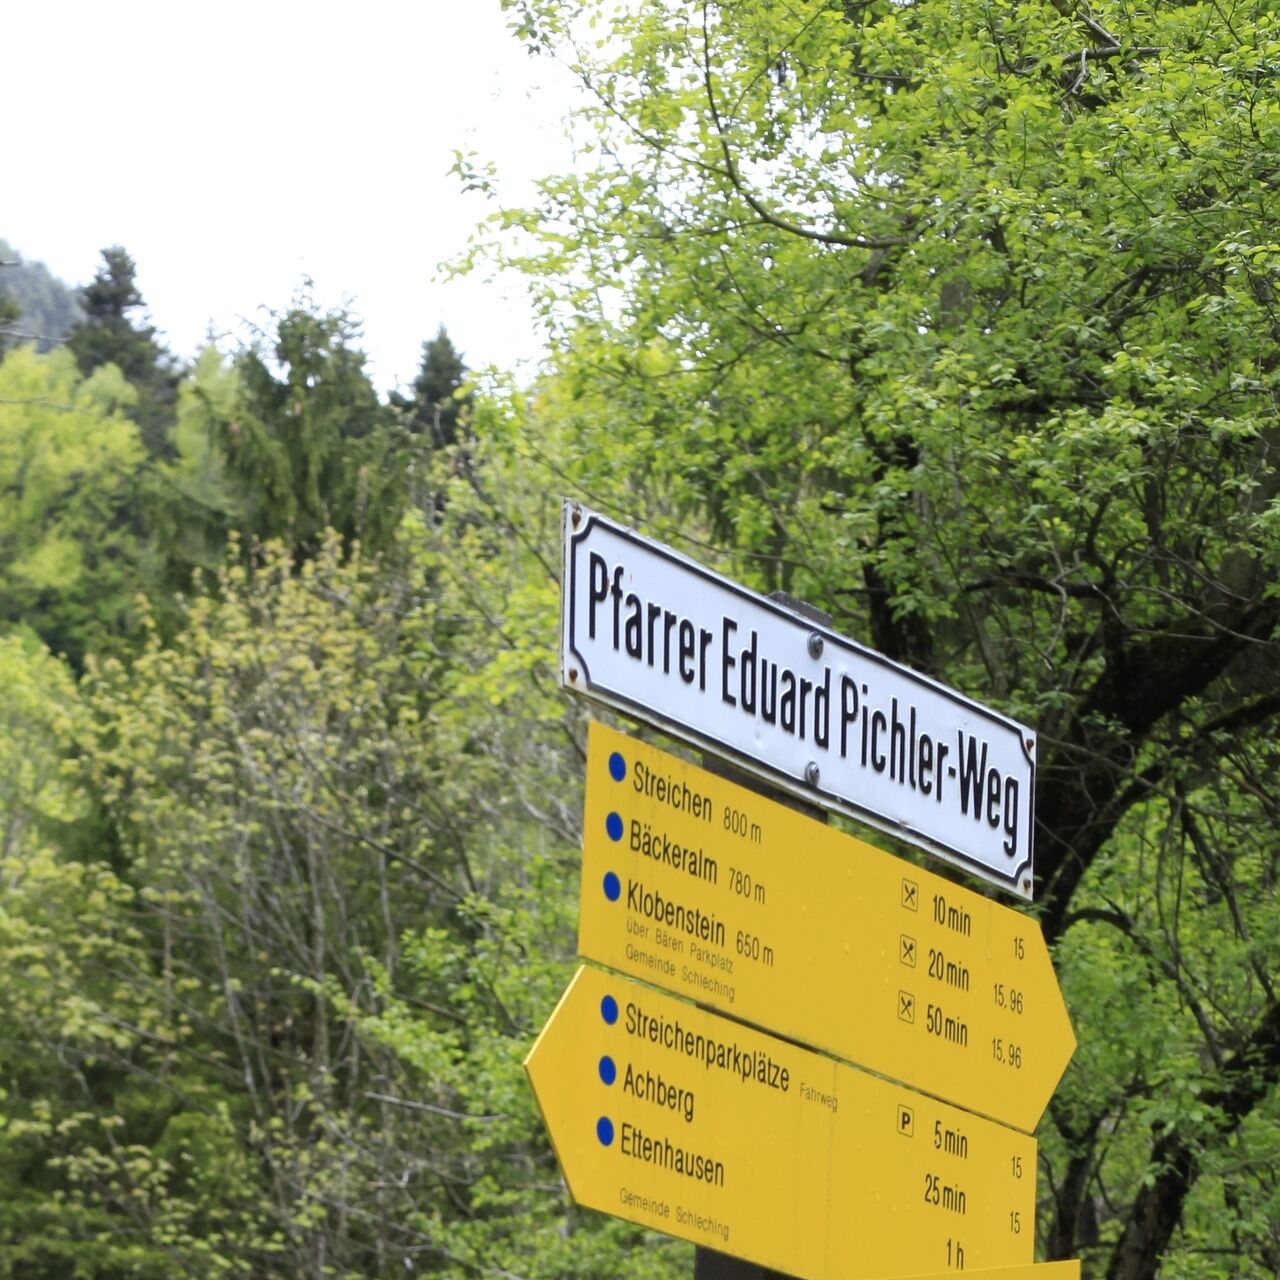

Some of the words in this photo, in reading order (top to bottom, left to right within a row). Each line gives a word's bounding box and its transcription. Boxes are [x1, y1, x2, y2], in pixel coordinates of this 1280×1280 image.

[588, 550, 713, 691] Pfarrer
[722, 616, 831, 750] Eduard
[840, 674, 1019, 857] Pichler-Weg
[633, 760, 712, 823] Streichen
[724, 806, 747, 837] 800
[751, 823, 761, 844] m
[630, 819, 717, 884] Bäckeralm
[729, 867, 751, 898] 780
[755, 884, 765, 904] m
[627, 879, 725, 947] Klobenstein
[736, 930, 760, 961] 650
[762, 946, 773, 967] m
[933, 894, 945, 925] 10
[948, 906, 971, 937] min
[627, 916, 649, 939] über
[655, 928, 684, 953] Bären
[690, 942, 734, 974] Parkplatz
[928, 948, 944, 981] 20
[946, 961, 970, 992] min
[1014, 937, 1025, 960] 15
[626, 943, 676, 976] Gemeinde
[682, 966, 735, 1003] Schleching
[926, 1003, 942, 1036] 50
[945, 1016, 968, 1047] min
[625, 1003, 790, 1092] Streichenparkplätze
[800, 1082, 838, 1113] Fahrweg
[623, 1063, 694, 1123] Achberg
[621, 1123, 724, 1187] Ettenhausen
[934, 1120, 942, 1149] 5
[944, 1128, 968, 1159] min
[924, 1173, 940, 1206] 25
[942, 1184, 966, 1215] min
[1011, 1156, 1022, 1179] 15
[620, 1187, 670, 1218] Gemeinde
[675, 1207, 730, 1240] Schleching
[1010, 1211, 1020, 1234] 15
[947, 1238, 952, 1267] 1
[956, 1241, 964, 1271] h
